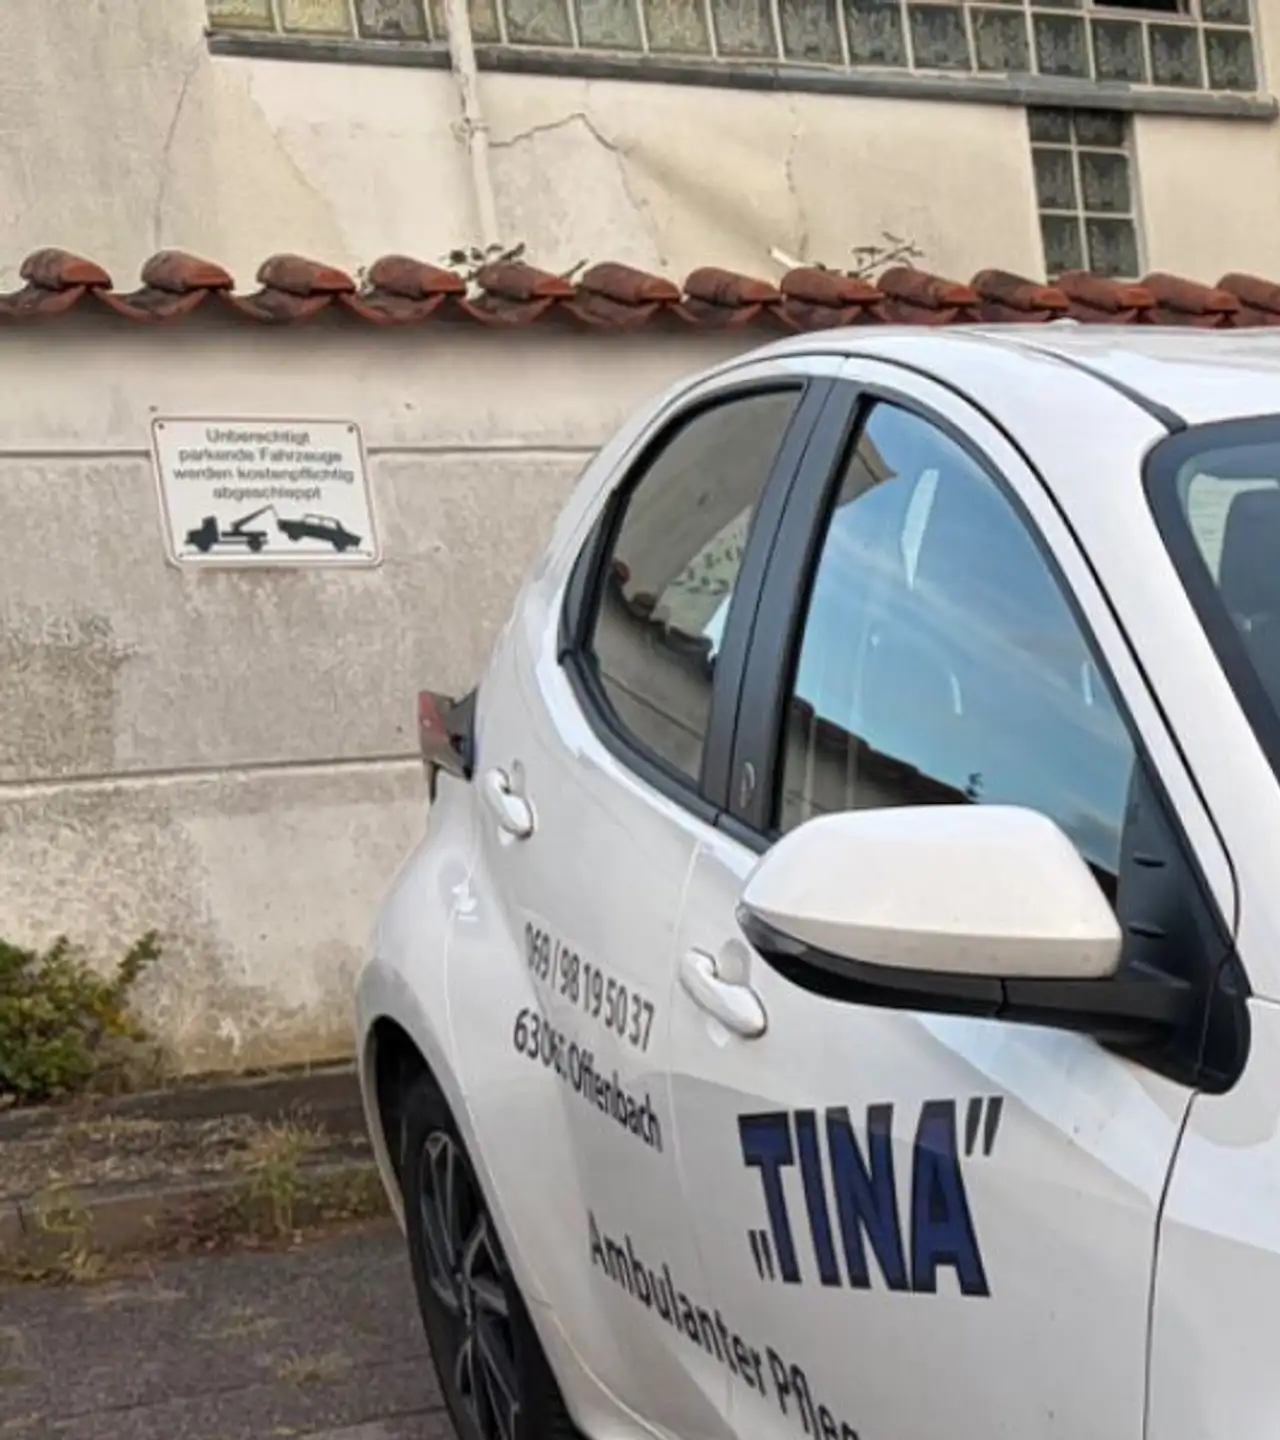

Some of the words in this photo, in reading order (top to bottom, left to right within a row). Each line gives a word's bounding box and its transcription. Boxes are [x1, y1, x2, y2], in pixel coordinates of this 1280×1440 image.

[205, 428, 310, 446] Unberechtigt
[178, 449, 255, 464] parkende
[260, 448, 343, 464] Fahrzeuge
[172, 468, 234, 480] werden
[237, 467, 356, 485] kostenpflichtig
[212, 485, 322, 501] abgeschleppt
[524, 920, 549, 982] 069
[560, 946, 580, 1005] 98
[583, 962, 604, 1019] 19
[604, 976, 628, 1037] 50
[629, 993, 655, 1053] 37
[567, 1041, 664, 1154] Offenbach
[587, 1207, 767, 1398] Ambulanter
